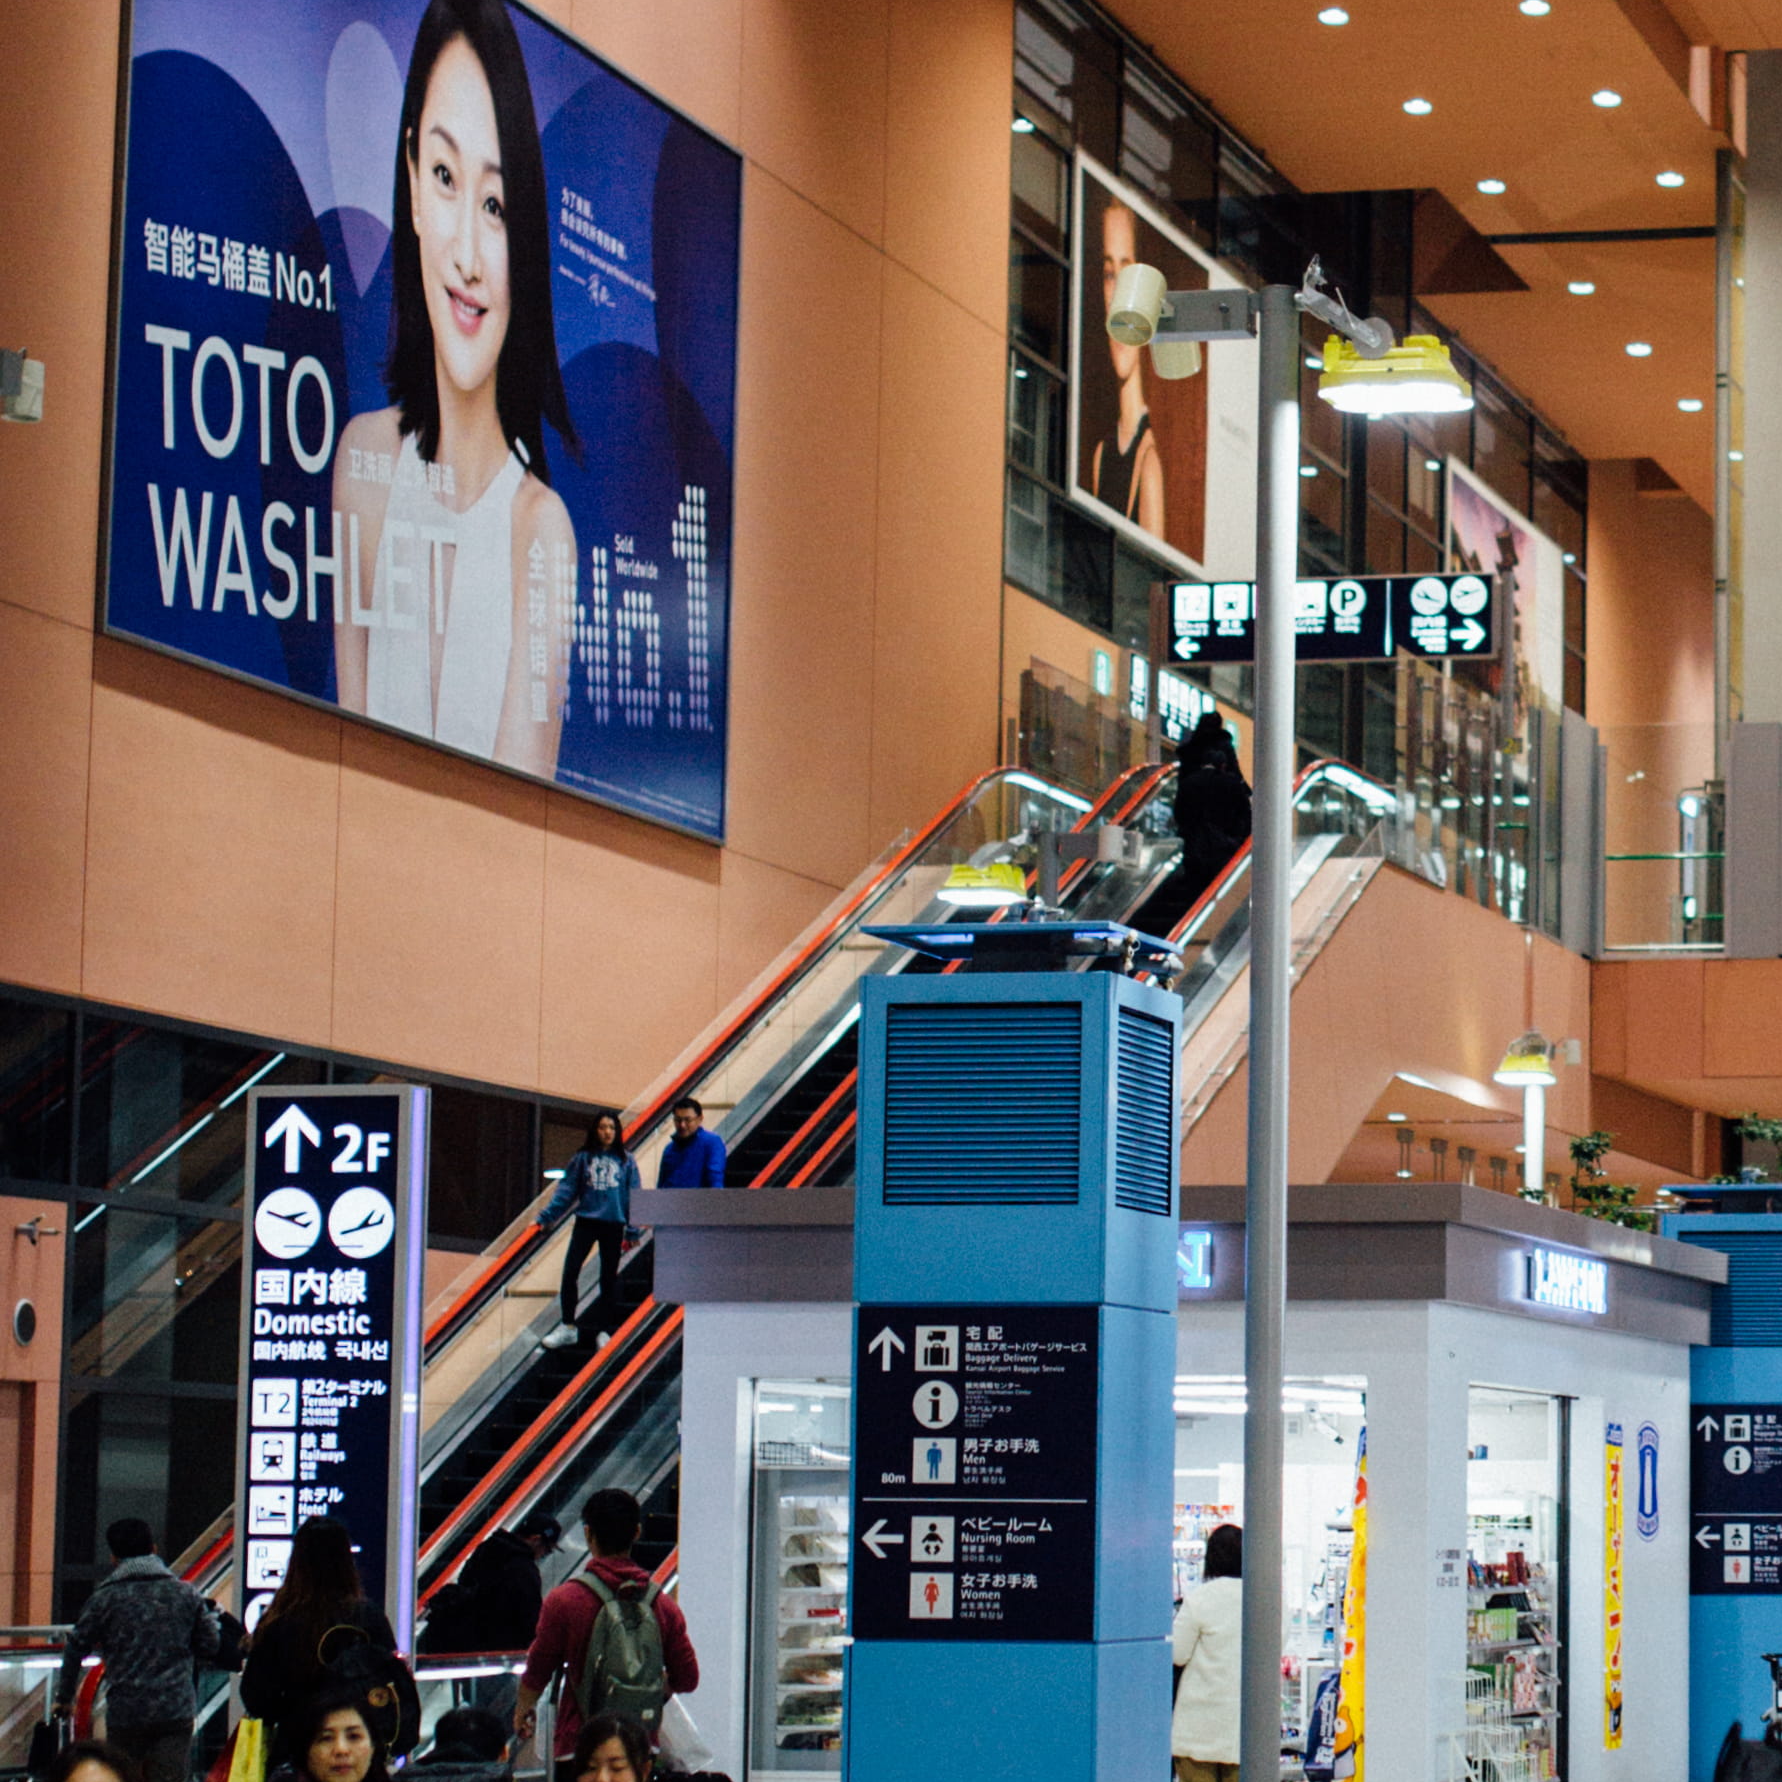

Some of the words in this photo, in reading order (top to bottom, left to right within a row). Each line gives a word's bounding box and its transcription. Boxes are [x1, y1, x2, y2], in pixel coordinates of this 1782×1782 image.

[143, 217, 272, 298] 智能马桶盖
[145, 323, 336, 475] TOTO
[615, 533, 634, 554] Sold
[147, 481, 458, 636] WASHLET
[615, 556, 660, 580] Worldwide
[331, 1122, 391, 1173] 2F
[254, 1268, 367, 1306] 国内線
[253, 1308, 371, 1336] Domestic
[334, 1340, 389, 1361] 국내선
[964, 1353, 1001, 1365] Baggage
[1003, 1352, 1038, 1365] Delivery
[301, 1378, 387, 1396] 第2ターミナル
[301, 1395, 348, 1408] Terminal
[350, 1395, 359, 1408] 2
[963, 1437, 1040, 1454] 男子お手洗
[300, 1449, 347, 1464] Railways
[962, 1454, 987, 1465] Men
[881, 1472, 906, 1484] 80m
[299, 1487, 345, 1503] ホテル
[298, 1502, 328, 1516] Hotel
[961, 1517, 1053, 1532] ベビールーム
[961, 1532, 1002, 1546] Nursing
[1005, 1532, 1036, 1544] Room
[960, 1573, 1038, 1589] 女子お手洗
[960, 1589, 1001, 1600] Women
